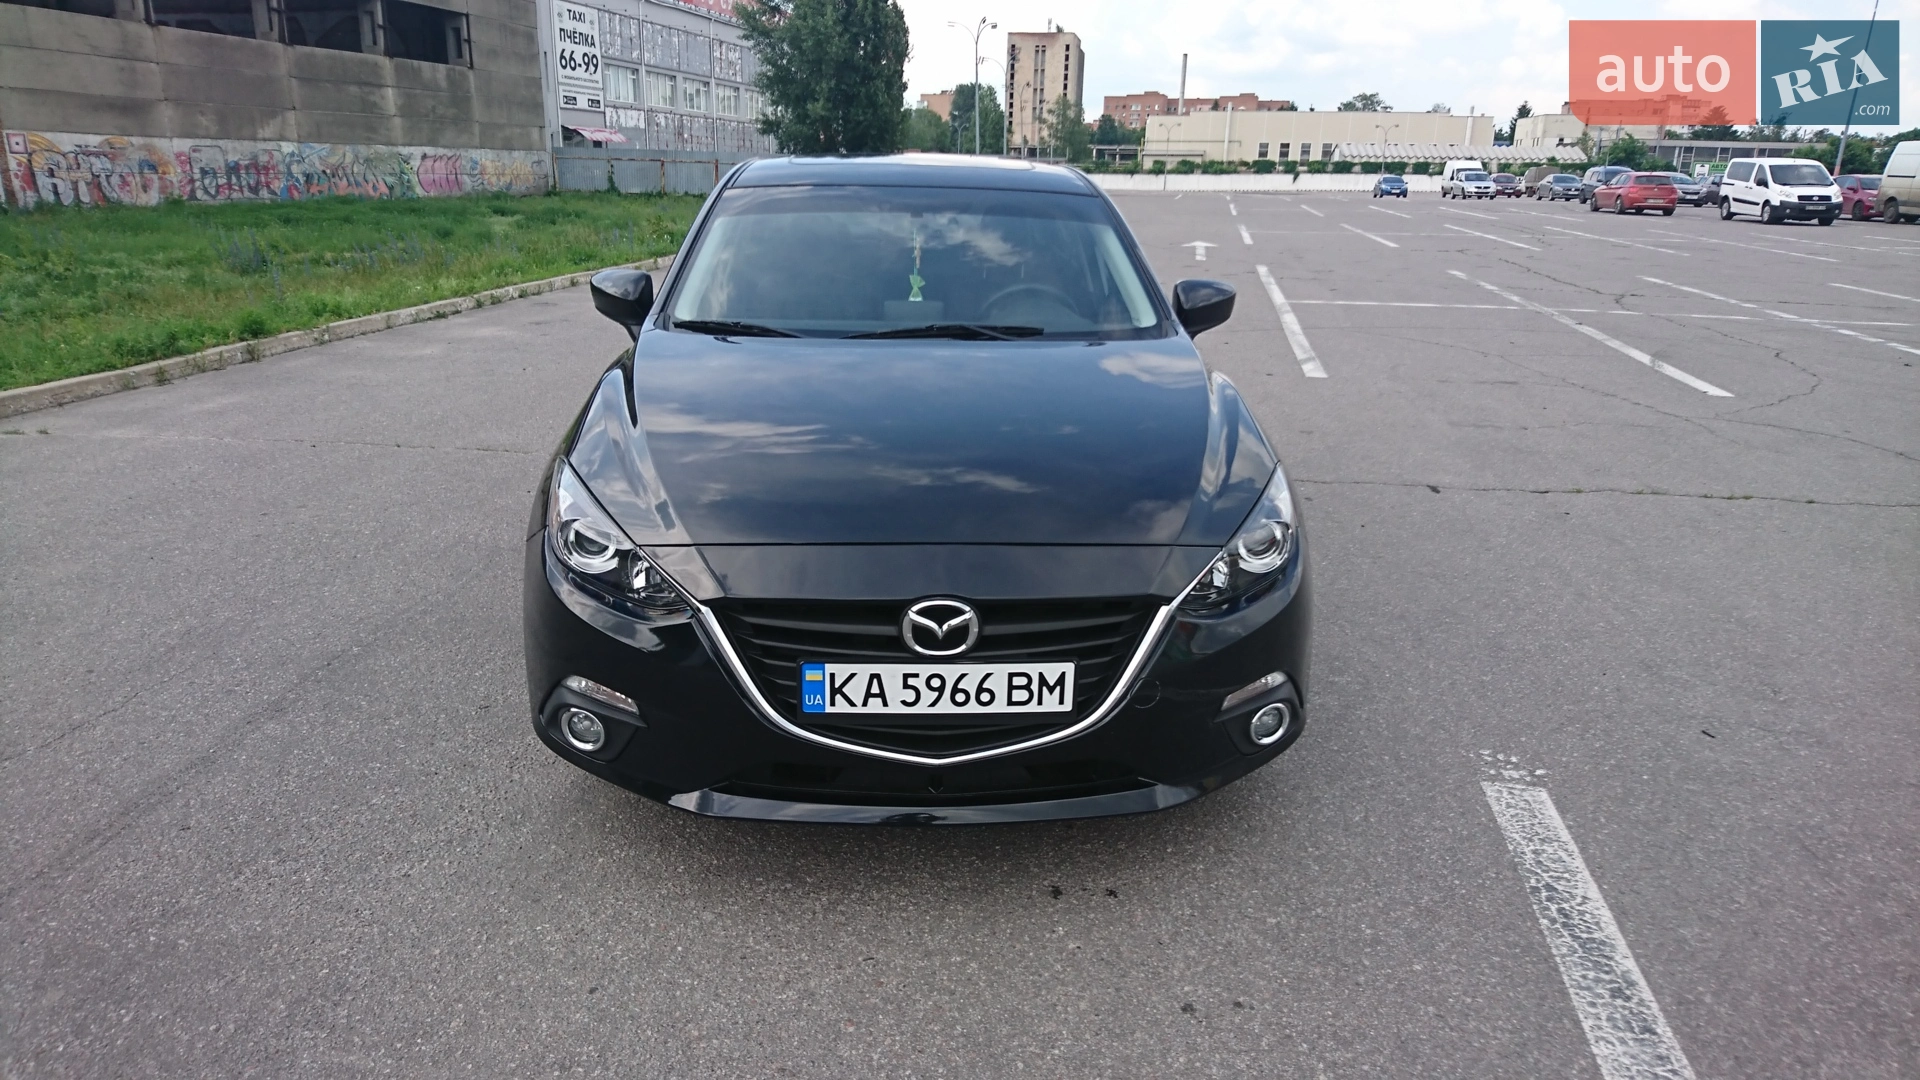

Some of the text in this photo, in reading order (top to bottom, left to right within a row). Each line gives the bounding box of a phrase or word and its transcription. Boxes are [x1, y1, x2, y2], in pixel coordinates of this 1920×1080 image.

[566, 8, 586, 24] TAXI
[559, 27, 596, 49] ПЧЁЛКА
[559, 48, 599, 75] 66-99
[805, 694, 823, 706] UA
[828, 671, 1067, 708] KA 5966 BM
